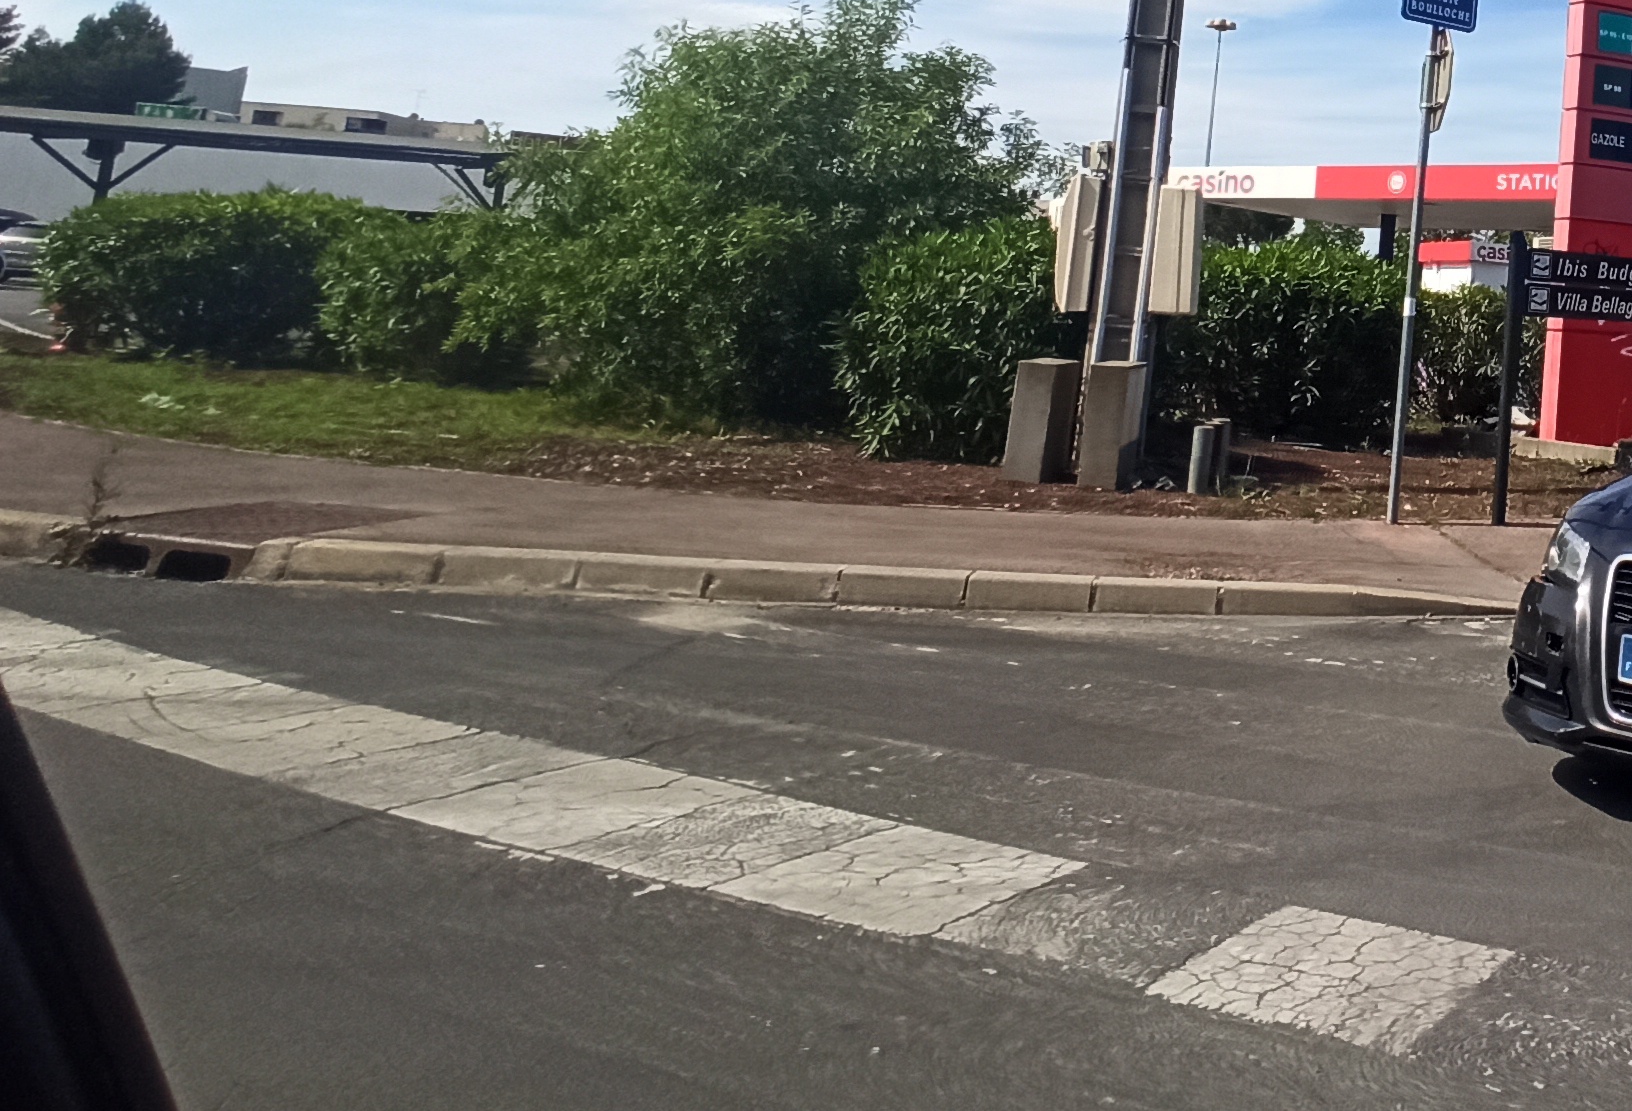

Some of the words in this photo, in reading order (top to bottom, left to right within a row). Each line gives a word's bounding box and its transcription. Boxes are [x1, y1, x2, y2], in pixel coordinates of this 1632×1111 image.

[1411, 0, 1470, 22] BOULLOCHE
[1591, 132, 1626, 148] GAZOLE
[1556, 258, 1588, 278] Ibis
[1557, 292, 1587, 313] Villa
